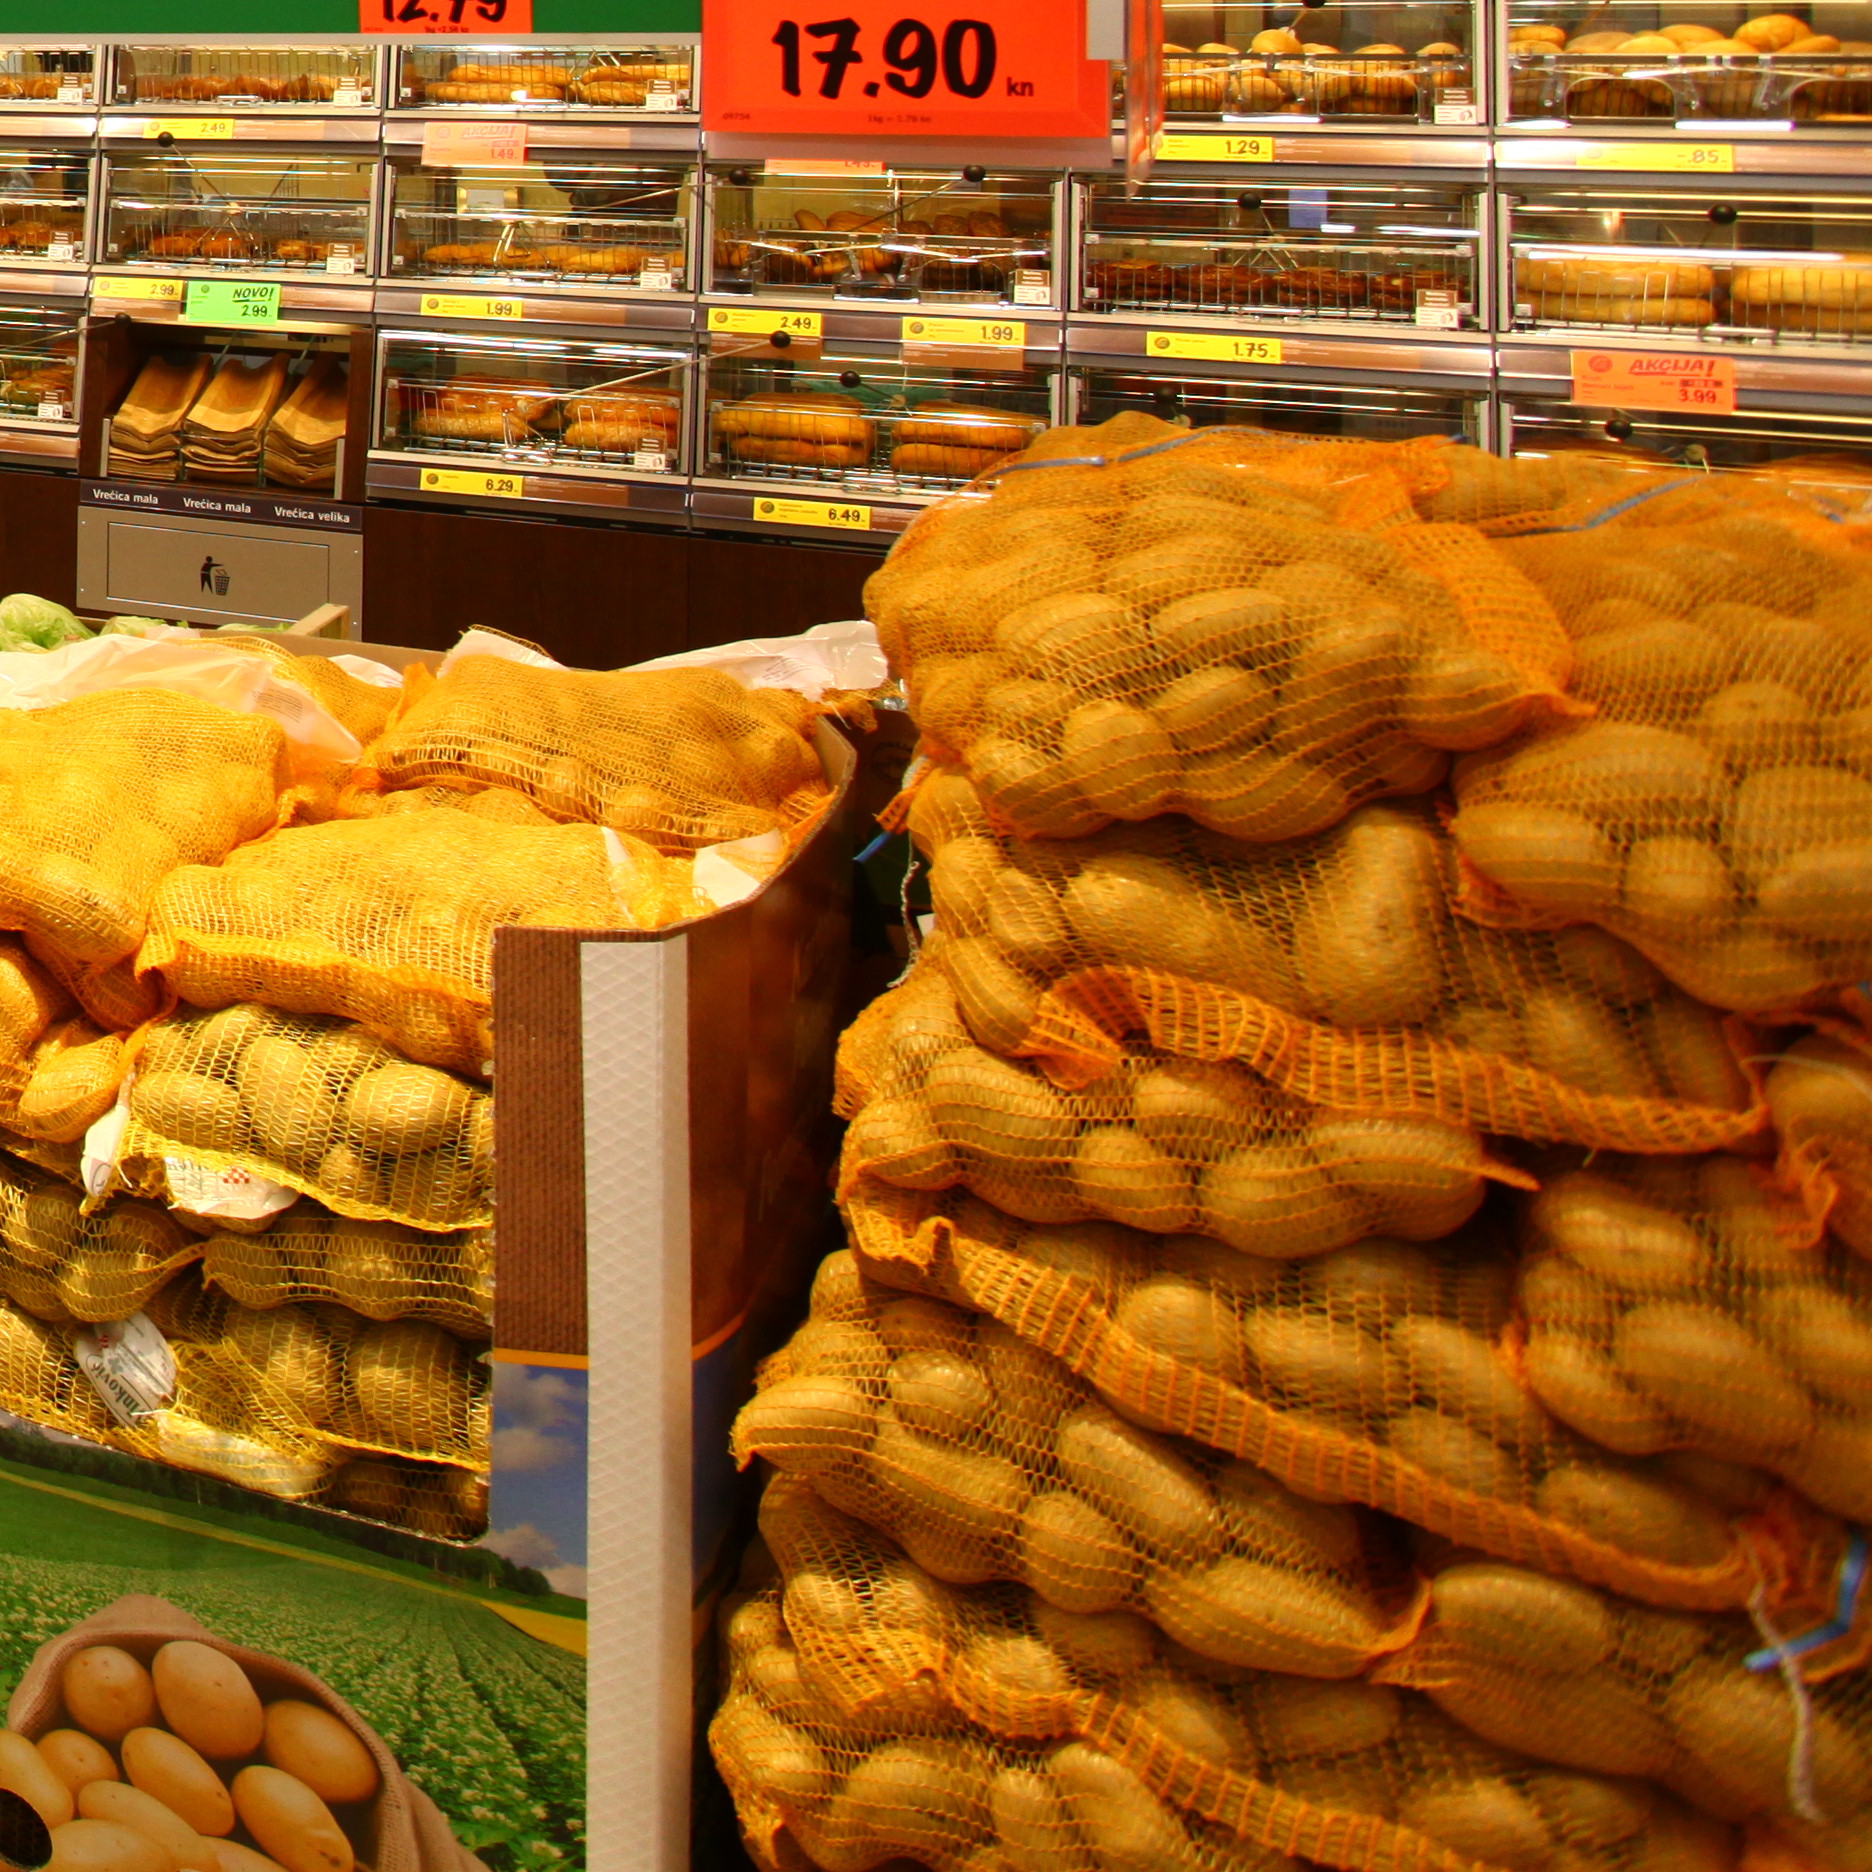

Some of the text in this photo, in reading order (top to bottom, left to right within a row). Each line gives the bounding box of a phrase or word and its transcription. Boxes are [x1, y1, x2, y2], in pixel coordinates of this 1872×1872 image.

[771, 17, 1033, 98] 17.90 kn
[1224, 139, 1262, 157] 1.29
[233, 287, 274, 301] NOVO!
[485, 303, 512, 315] 1.99
[780, 316, 811, 329] 2.49
[980, 325, 1014, 342] 1.99
[1232, 342, 1270, 358] 1.75
[1629, 358, 1715, 377] AKCIJA!
[485, 479, 513, 493] 6.29
[93, 489, 158, 504] Vrećica mala
[275, 507, 350, 523] Vrećica velika
[828, 508, 860, 523] 6.49
